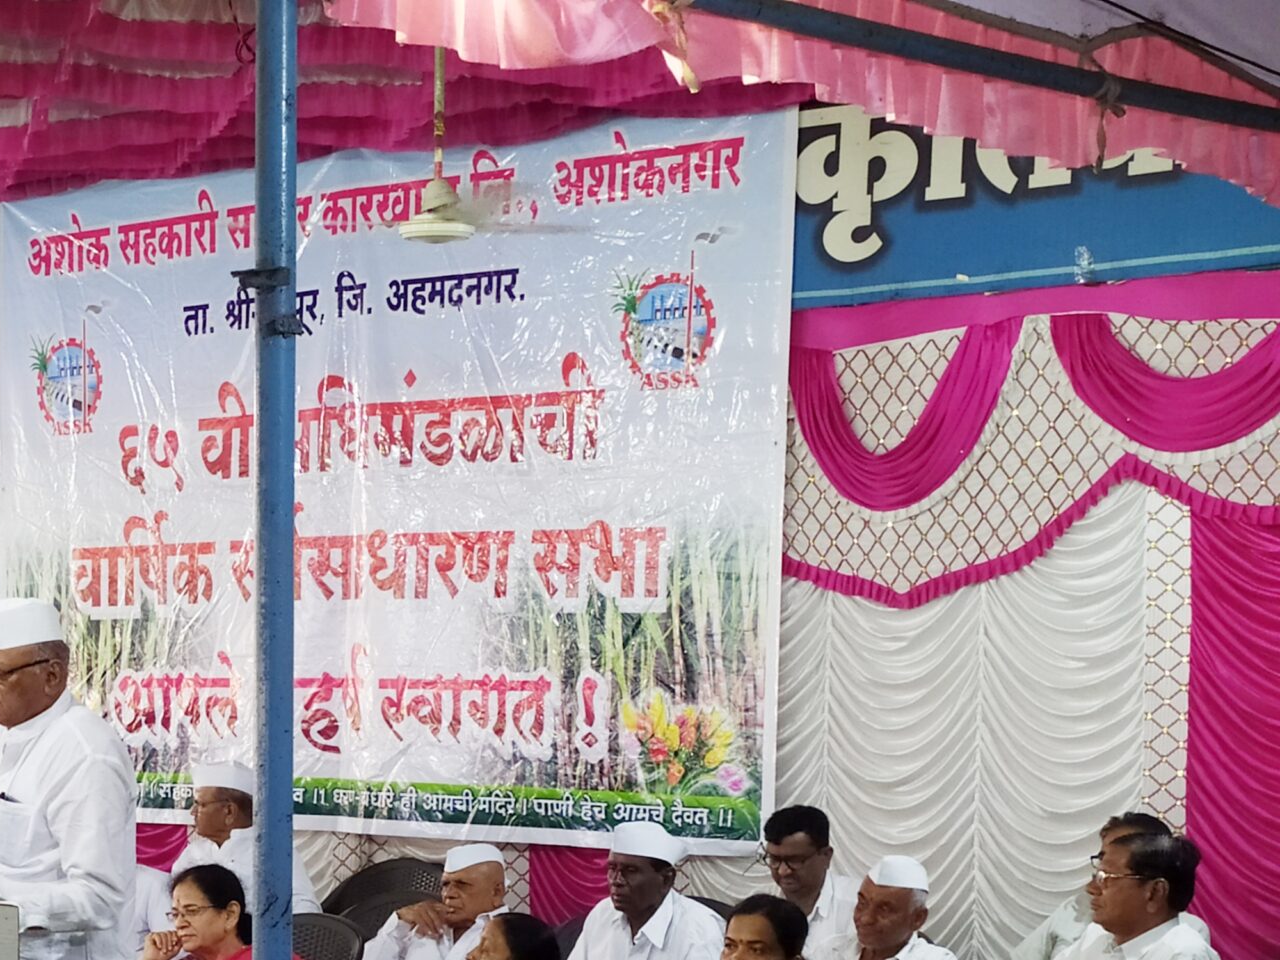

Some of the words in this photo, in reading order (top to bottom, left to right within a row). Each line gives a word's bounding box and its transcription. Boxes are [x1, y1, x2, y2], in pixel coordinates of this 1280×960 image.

[27, 213, 110, 276] अशोक
[118, 189, 219, 266] सहकारी
[553, 131, 745, 207] अशोकनगर
[183, 303, 215, 336] ता.
[335, 270, 373, 319] जि.
[386, 267, 526, 316] अहमदनगर.
[119, 423, 184, 495] ६५
[198, 381, 255, 481] वी
[72, 509, 217, 609] वार्षिक
[531, 520, 666, 600] सभा
[114, 650, 239, 739] आपले
[379, 673, 552, 746] स्वागत
[580, 677, 603, 749] !
[423, 789, 474, 813] आमची
[532, 791, 574, 819] पाणी
[580, 793, 608, 821] हेच
[613, 799, 665, 823] आमचे
[671, 797, 709, 826] दैवत
